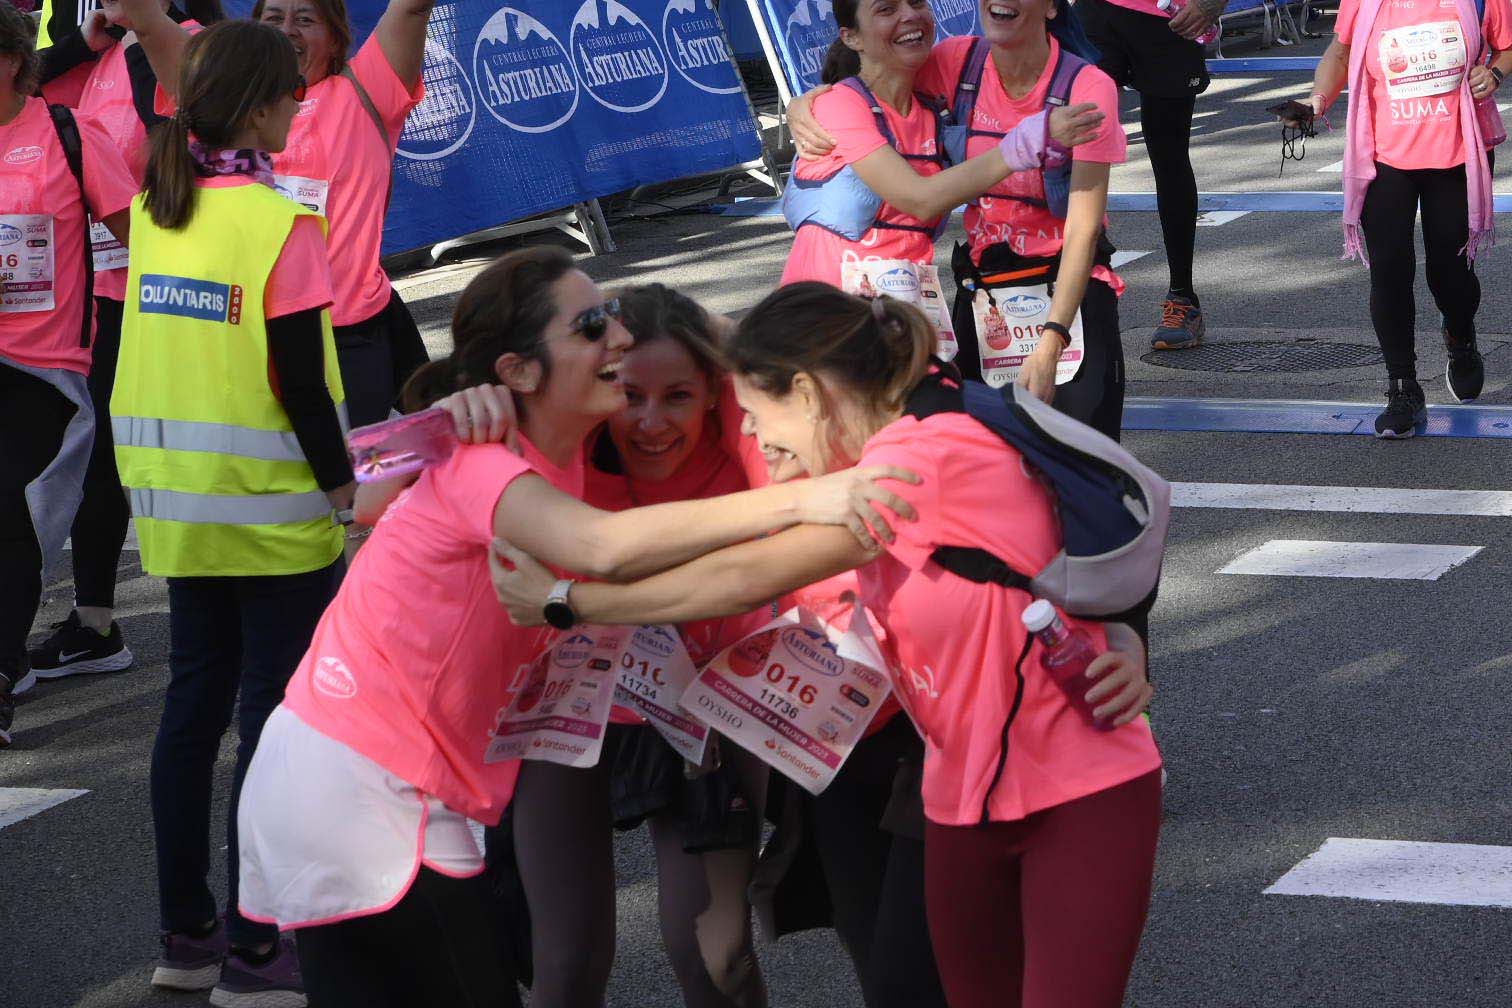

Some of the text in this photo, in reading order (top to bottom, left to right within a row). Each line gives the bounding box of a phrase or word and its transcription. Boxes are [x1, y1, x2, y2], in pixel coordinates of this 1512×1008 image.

[681, 19, 714, 34] CENTRAL
[493, 45, 560, 66] CENTRAL LECHERA
[586, 34, 616, 49] CENTRAL
[671, 25, 731, 70] ASTUR
[578, 42, 664, 88] ASTURIANA
[1410, 49, 1438, 64] 016
[483, 58, 575, 108] ASTURIANA
[1391, 98, 1449, 120] SUMA
[0, 254, 18, 267] 16
[14, 297, 47, 305] Santander
[141, 284, 225, 312] OLUNTARIS
[230, 287, 241, 323] 2000
[1013, 324, 1046, 339] 016
[994, 358, 1022, 366] CARRERA
[784, 631, 838, 674] ASTURIANA
[620, 673, 657, 699] 11734
[766, 662, 818, 706] 016
[697, 694, 744, 729] OYSHO
[713, 678, 753, 712] CARRERA
[752, 705, 766, 720] DE
[766, 713, 780, 728] LA
[778, 720, 810, 747] MUJER
[759, 688, 800, 720] 11736
[775, 744, 822, 780] Santander
